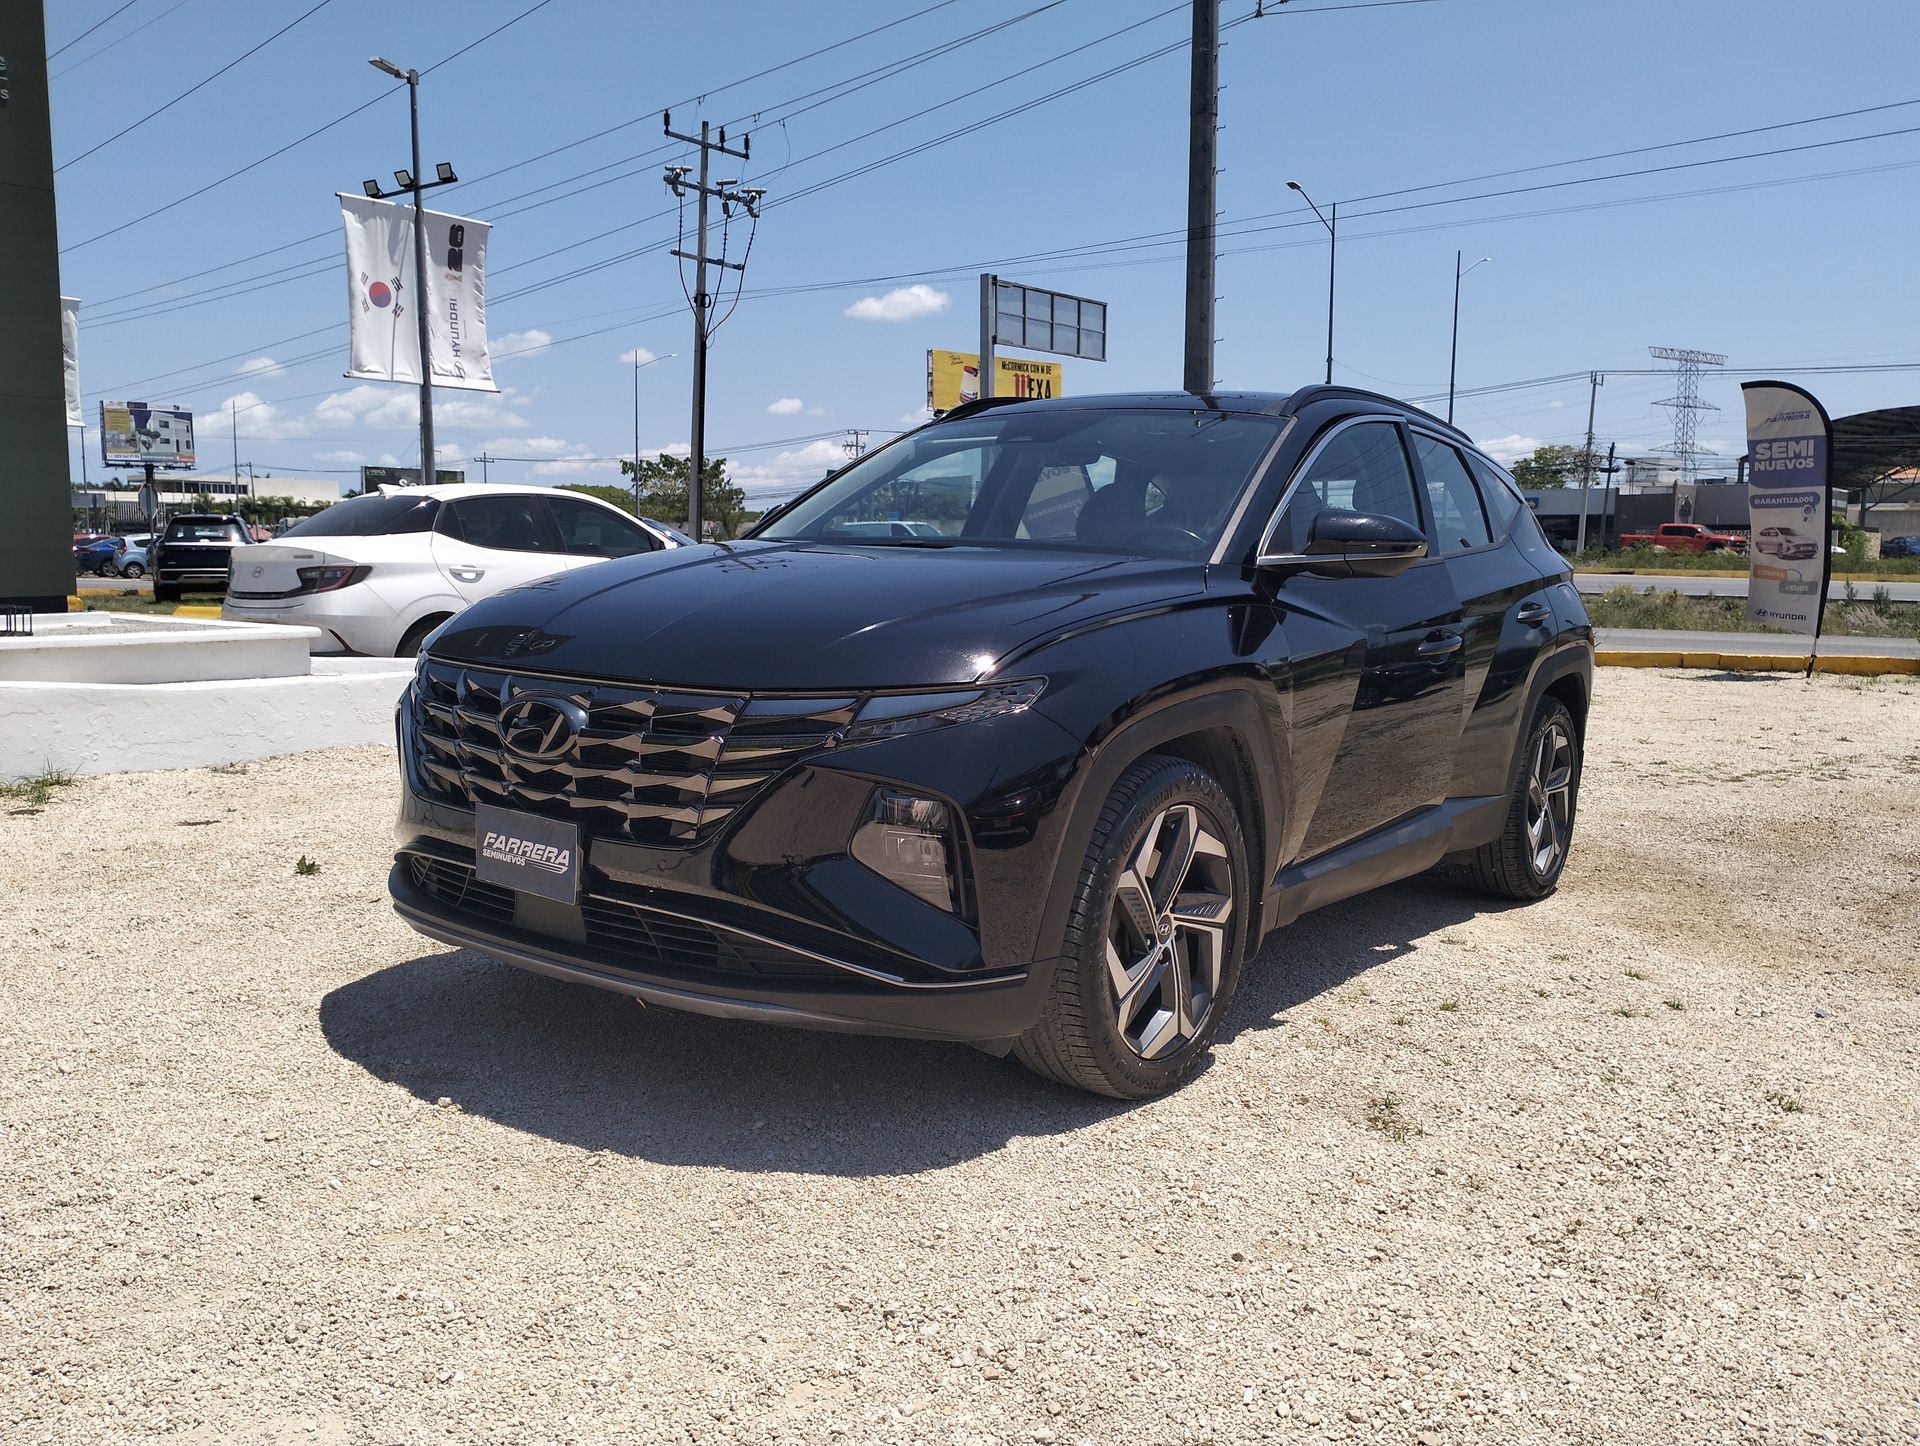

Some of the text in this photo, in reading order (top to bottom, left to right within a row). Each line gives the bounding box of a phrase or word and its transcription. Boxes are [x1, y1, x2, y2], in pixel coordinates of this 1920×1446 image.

[447, 223, 465, 273] 26
[449, 298, 461, 358] HYUNDAI
[1001, 361, 1029, 374] McCORMICK
[1030, 364, 1040, 374] CON
[1046, 365, 1052, 375] DE
[1755, 439, 1815, 460] SEMI
[1754, 458, 1815, 472] NUEVOS
[1754, 495, 1814, 505] GARANTIZADOS
[1785, 583, 1809, 593] VENDE
[1769, 611, 1807, 621] HYUNDAI
[482, 848, 526, 866] SEMINUEVOS
[483, 832, 570, 867] FARRERA
